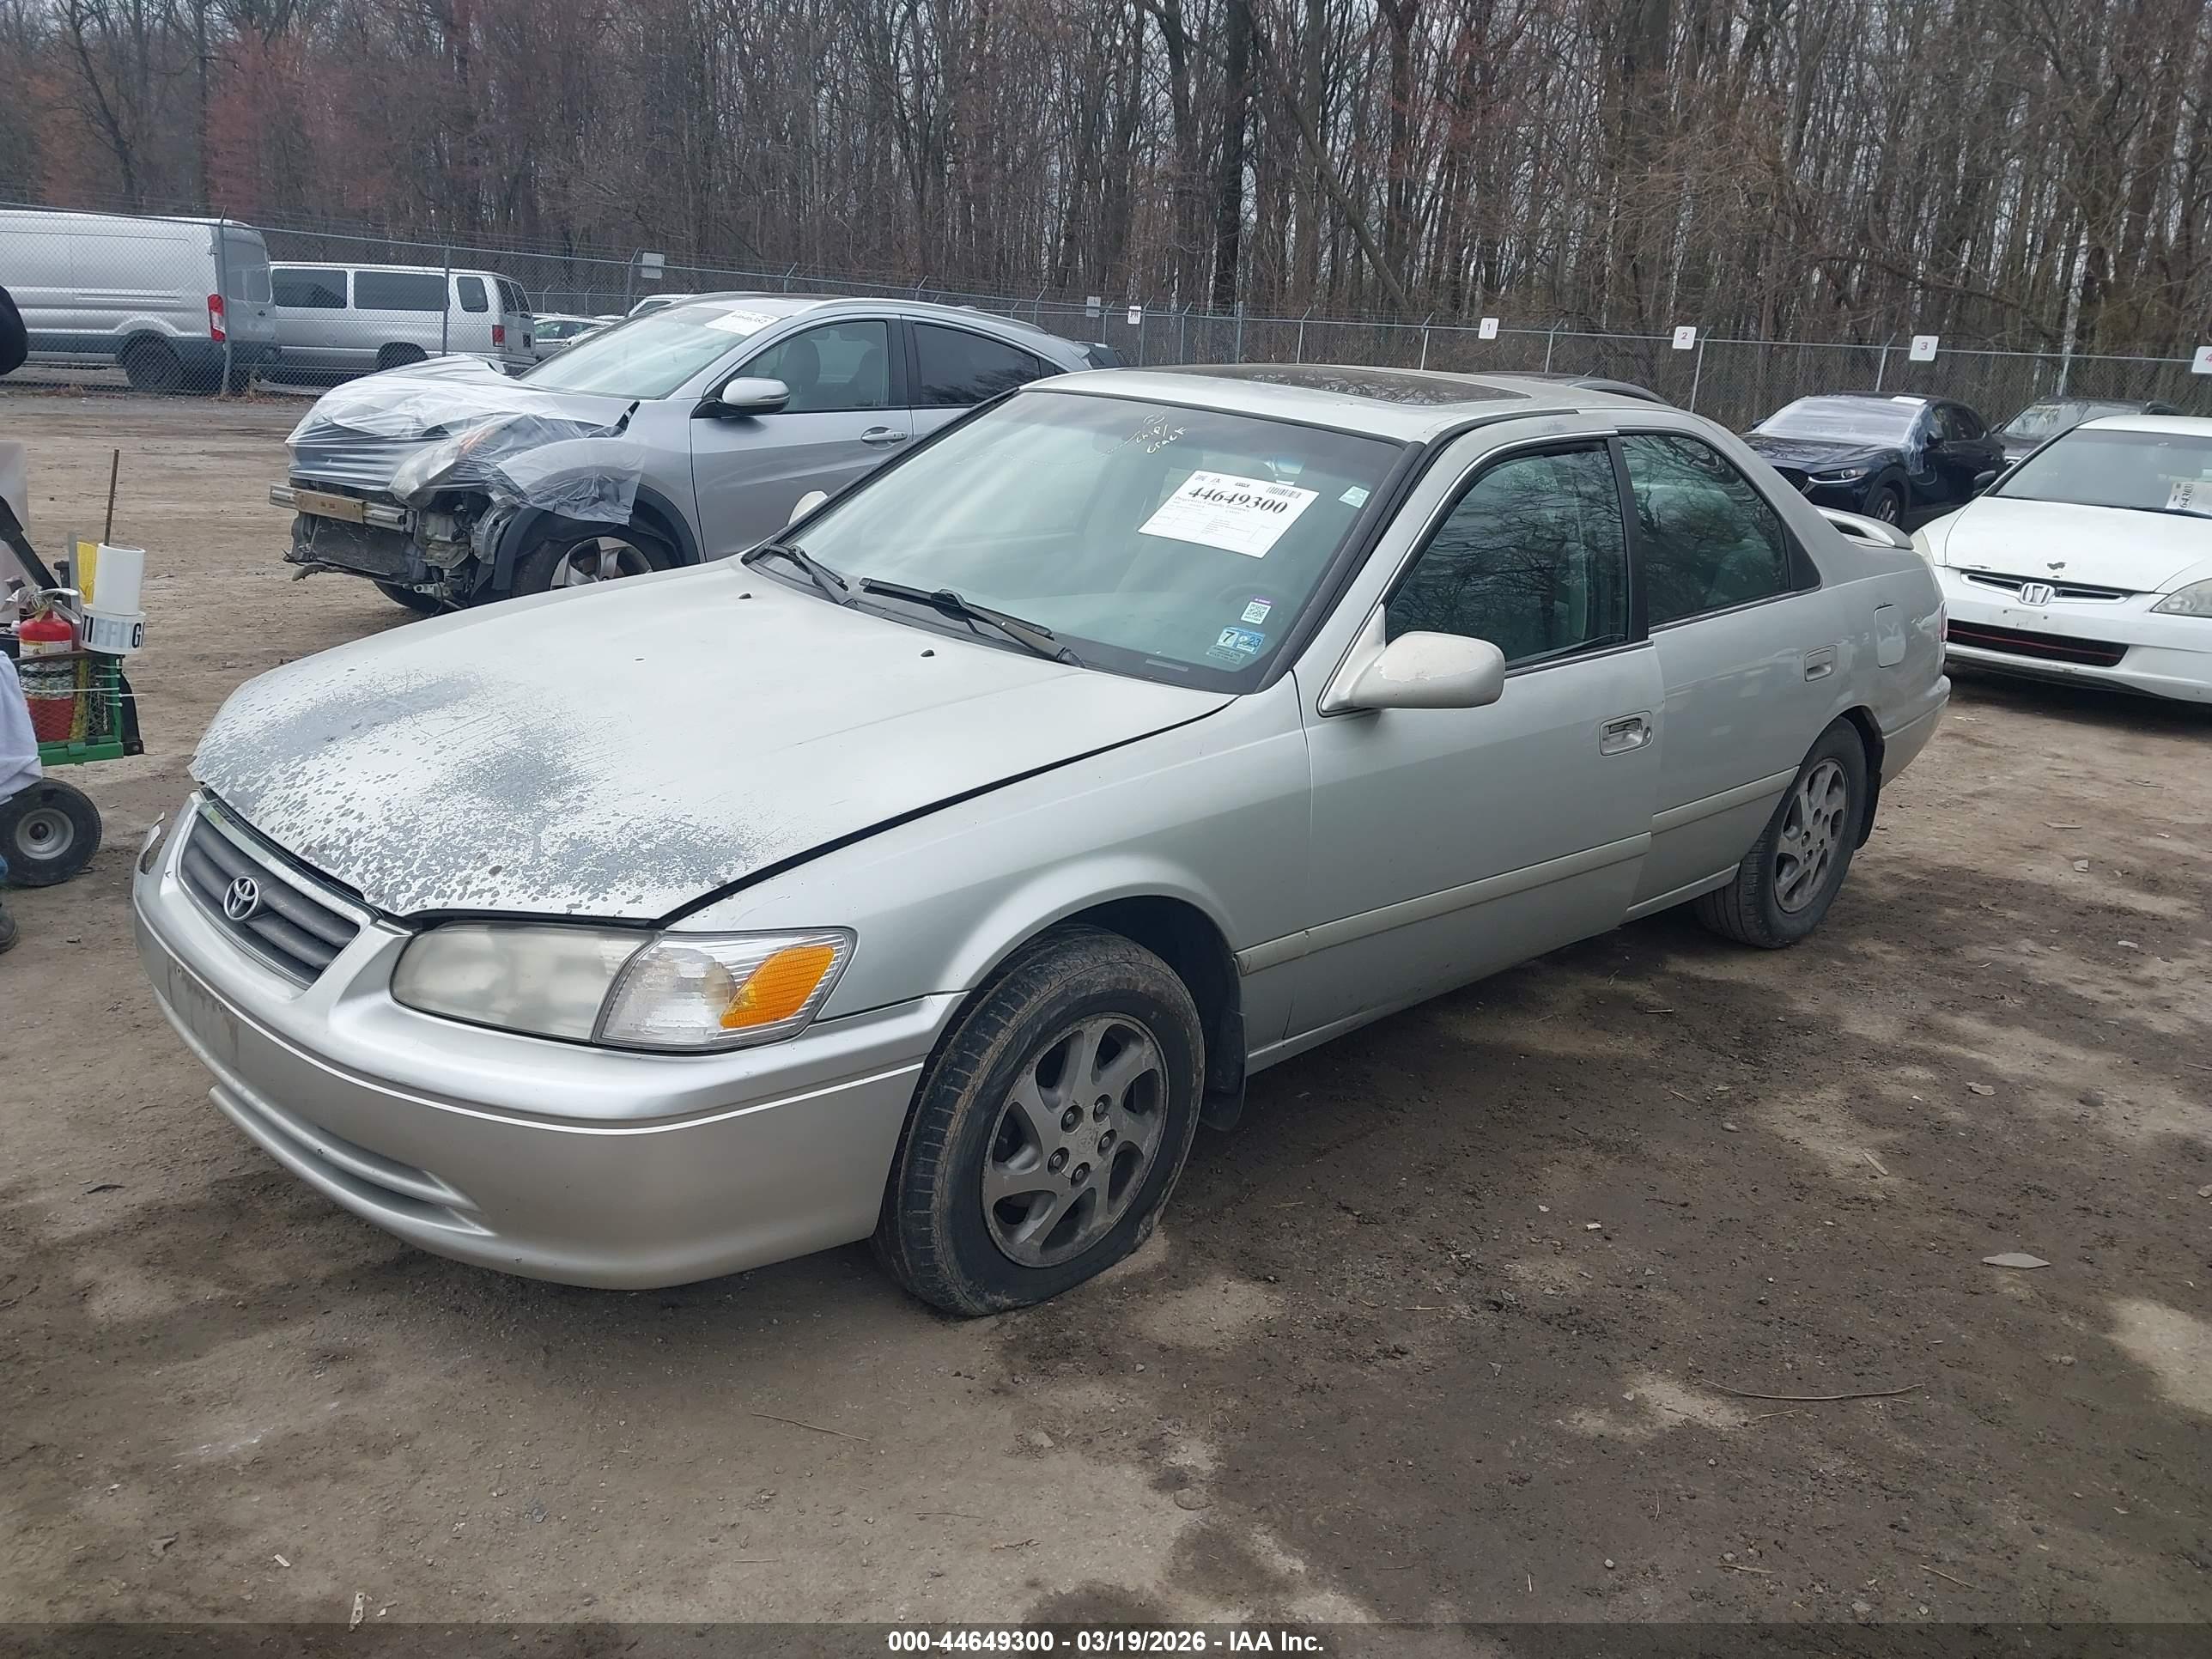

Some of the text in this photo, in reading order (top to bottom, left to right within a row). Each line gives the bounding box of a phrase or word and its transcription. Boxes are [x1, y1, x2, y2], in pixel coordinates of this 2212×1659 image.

[1680, 331, 1688, 340] 2
[1920, 342, 1929, 351] 3
[1188, 487, 1288, 514] 44649300
[1223, 630, 1236, 643] 7
